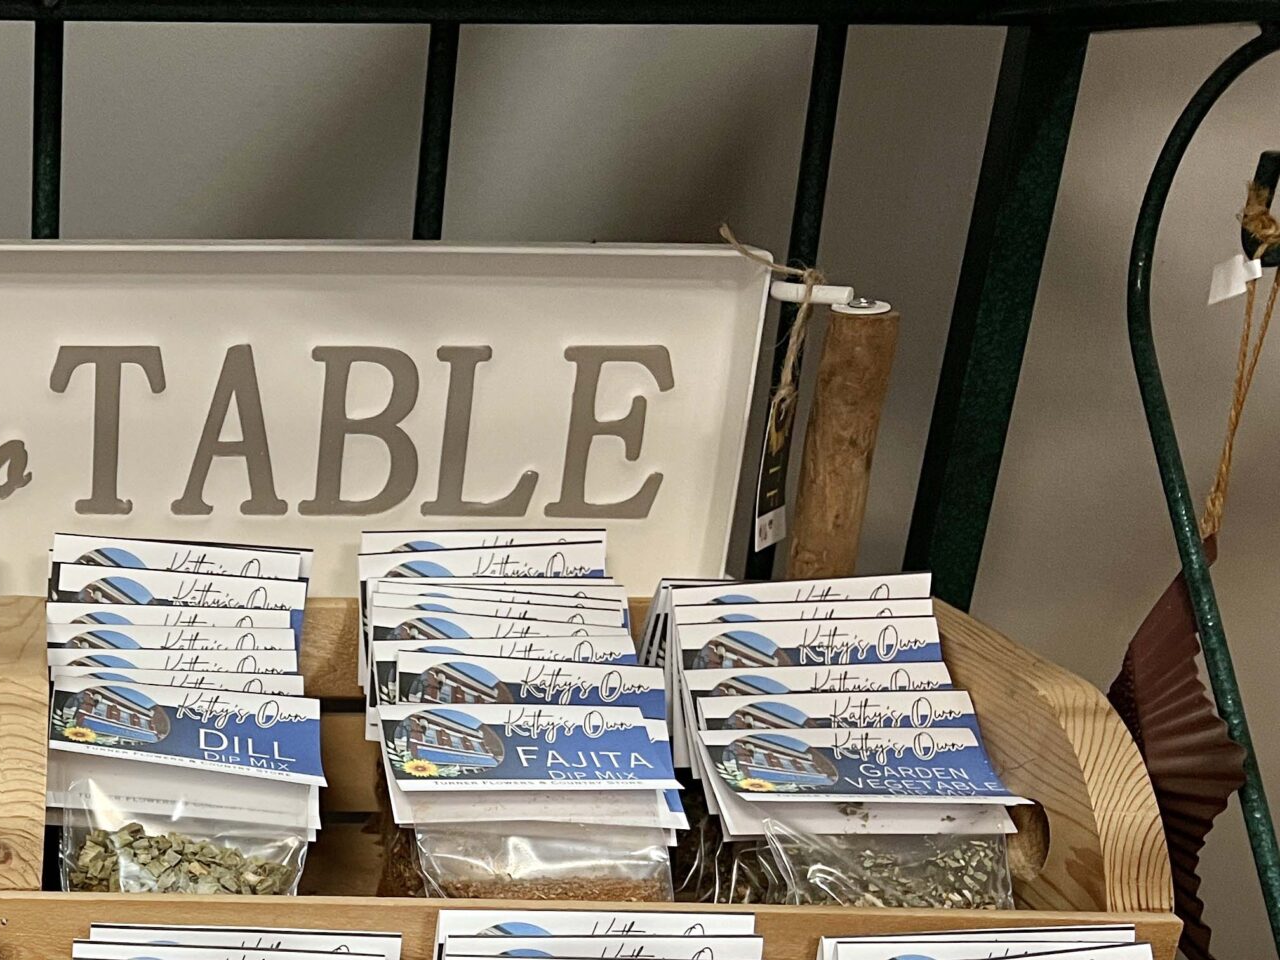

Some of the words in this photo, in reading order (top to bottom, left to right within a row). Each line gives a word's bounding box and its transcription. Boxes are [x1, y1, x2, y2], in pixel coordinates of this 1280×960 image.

[49, 343, 675, 519] TABLE
[798, 624, 870, 664] Kathy's
[876, 624, 926, 661] Own
[519, 666, 592, 704] Kathy's
[599, 670, 650, 702] Own
[176, 692, 249, 728] Kathy's
[256, 700, 308, 728] Own
[504, 707, 576, 742] Kathy's
[583, 710, 634, 738] Own
[911, 697, 962, 728] Own
[199, 728, 296, 761] DILL
[204, 751, 241, 764] DIP
[250, 758, 290, 771] MIX
[516, 746, 654, 769] FAJITA
[831, 732, 905, 764] Kathy's
[912, 731, 964, 760] Own
[548, 770, 586, 780] DIP
[594, 771, 638, 780] MIX
[844, 777, 1002, 791] VEGETABLE
[859, 763, 969, 780] GARDEN
